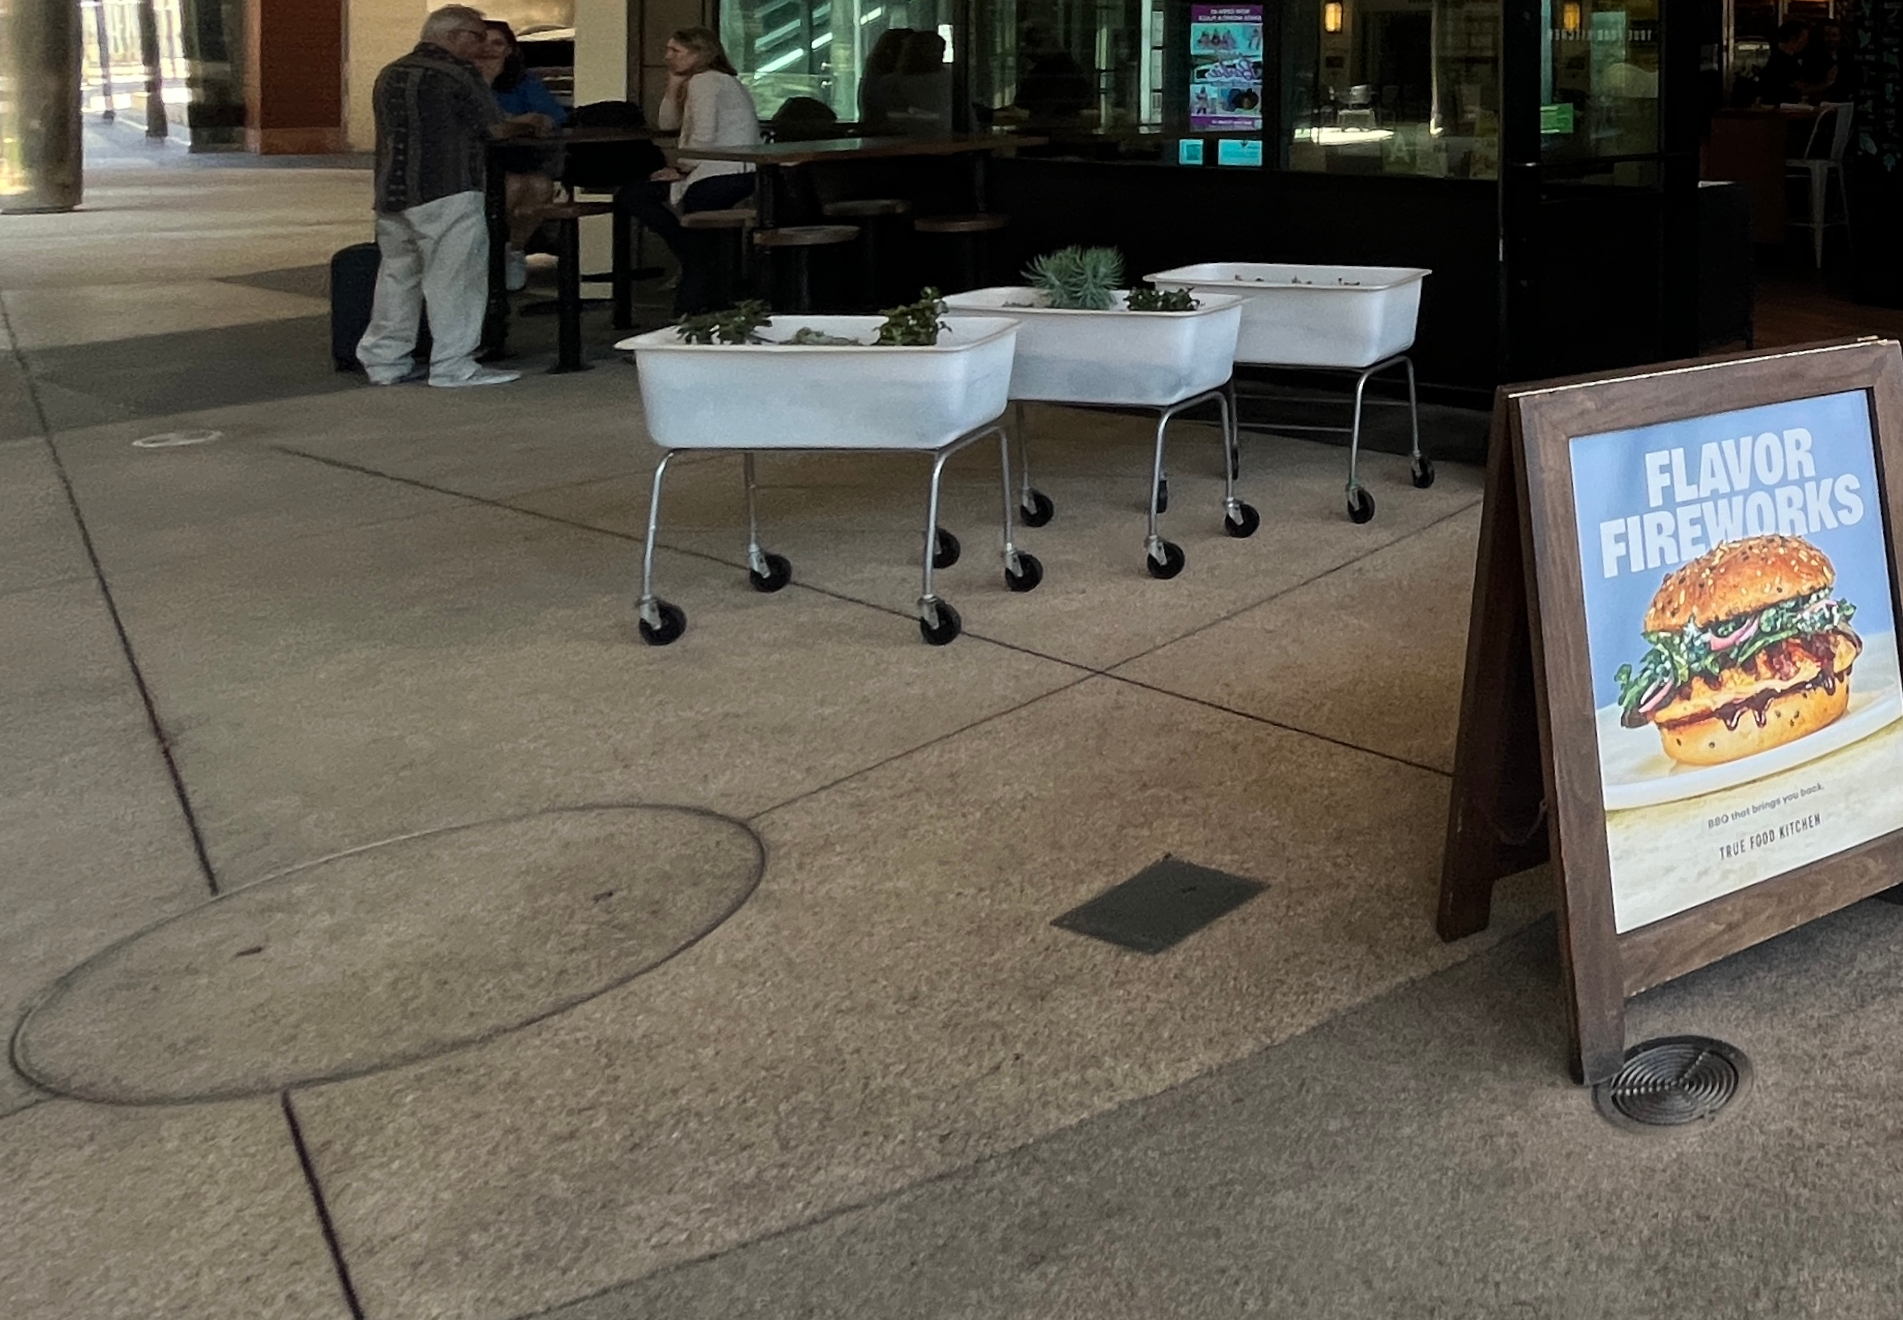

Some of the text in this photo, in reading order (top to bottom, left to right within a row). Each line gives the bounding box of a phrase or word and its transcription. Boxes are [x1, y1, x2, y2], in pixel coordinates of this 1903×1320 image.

[1643, 426, 1814, 508] FLAVOR
[1600, 473, 1866, 579] FIREWORKS
[1707, 814, 1730, 830] BBQ
[1731, 806, 1750, 822] that
[1751, 796, 1782, 815] brings
[1782, 791, 1800, 806] you
[1718, 812, 1822, 862] TRUE FOOD KITCHEN
